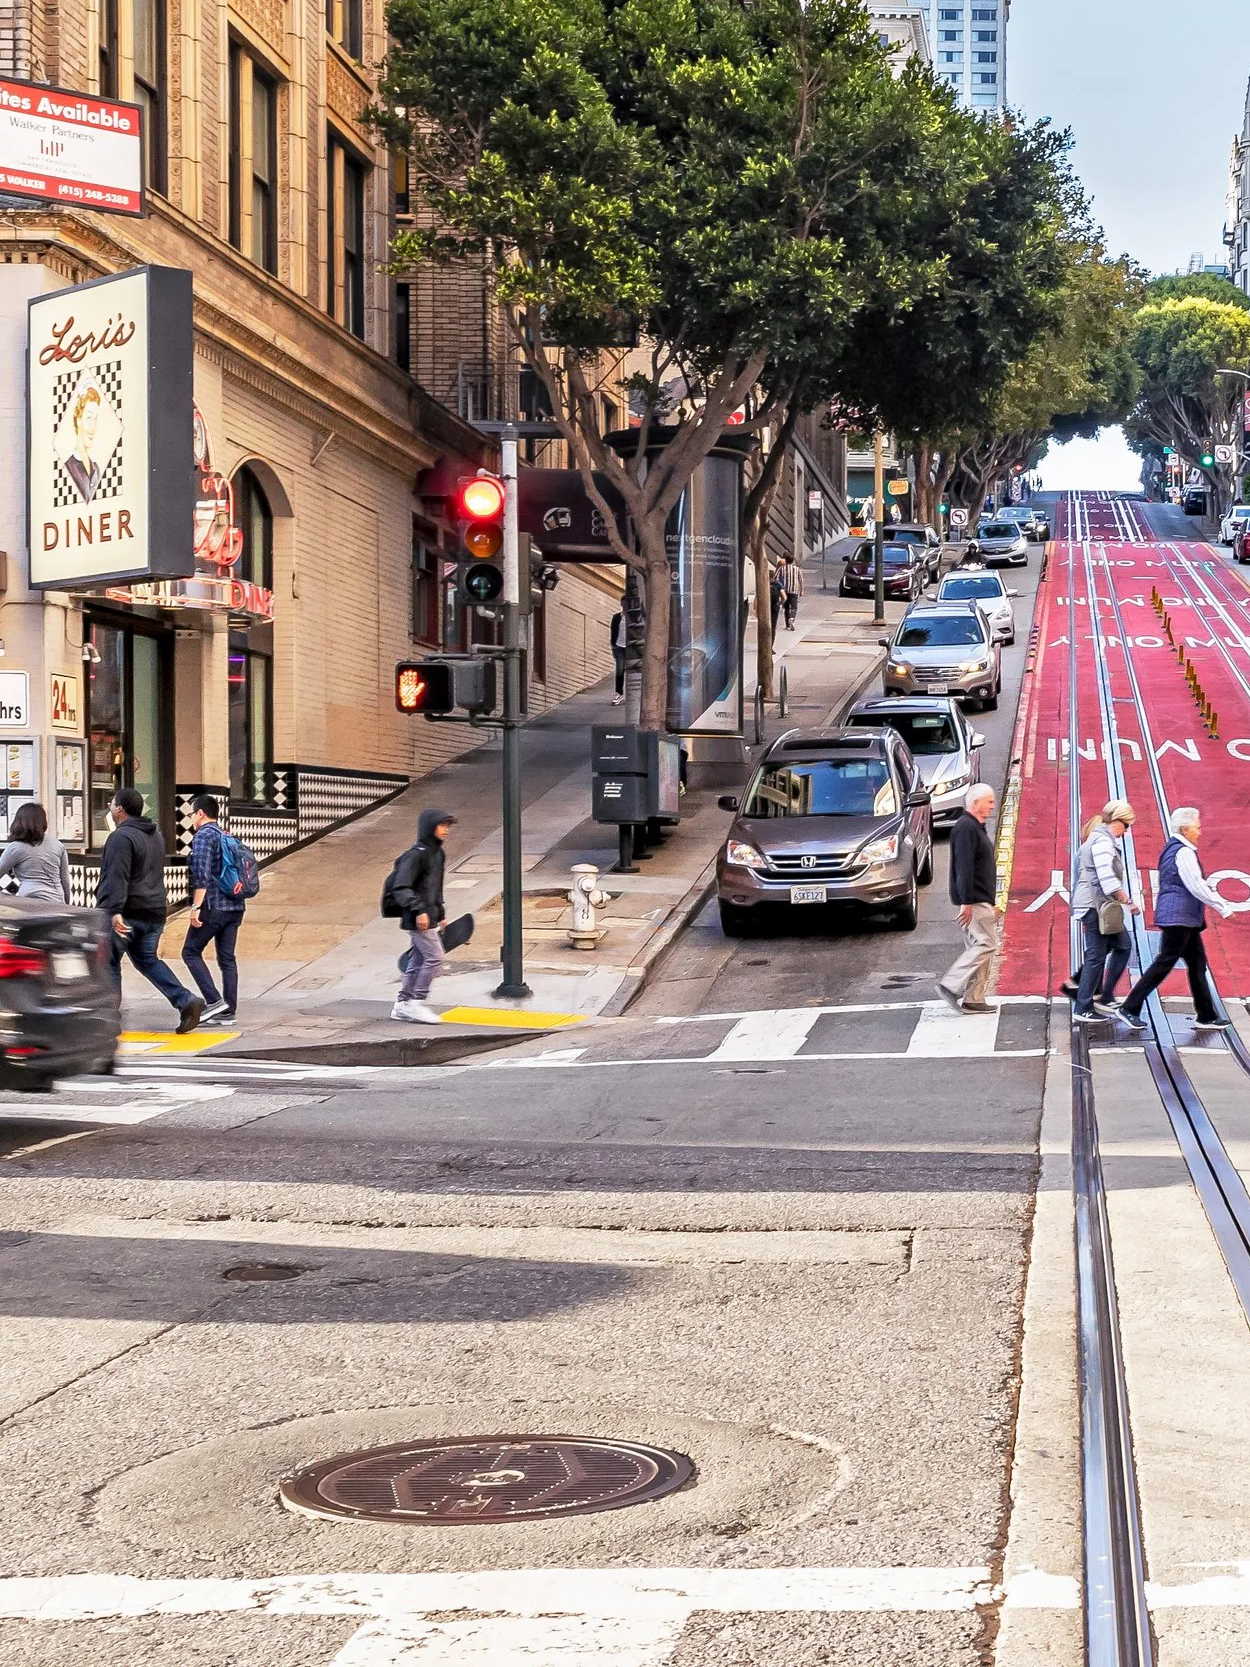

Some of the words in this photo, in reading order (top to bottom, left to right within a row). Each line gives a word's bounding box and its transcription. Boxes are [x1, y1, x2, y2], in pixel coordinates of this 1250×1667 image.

[37, 97, 131, 130] Available
[9, 116, 47, 132] Walker
[52, 125, 95, 142] Partners
[6, 174, 46, 190] WALKER
[58, 184, 83, 198] (415)
[39, 313, 135, 366] Lori's
[43, 509, 134, 551] DINER
[0, 701, 22, 720] hrs
[53, 679, 67, 721] 24
[1047, 738, 1202, 762] MUNI
